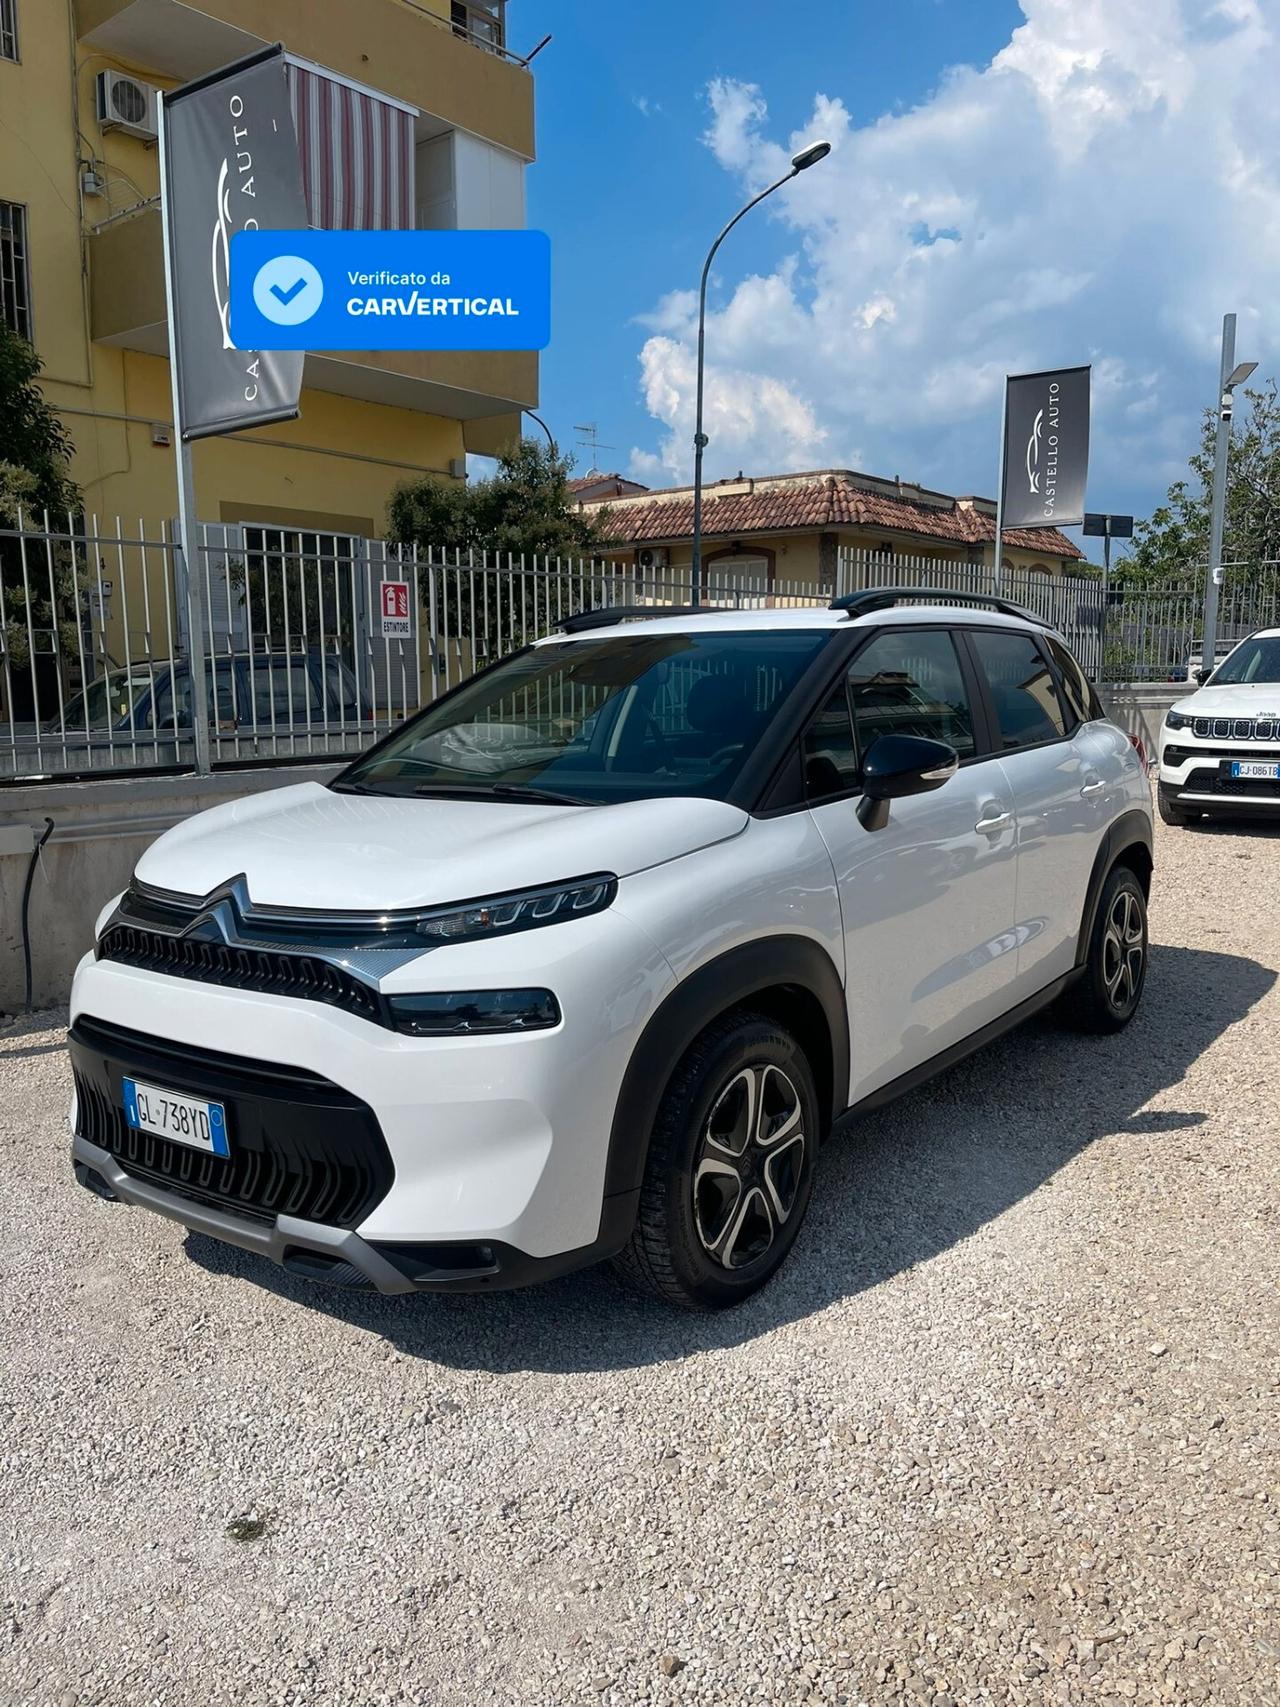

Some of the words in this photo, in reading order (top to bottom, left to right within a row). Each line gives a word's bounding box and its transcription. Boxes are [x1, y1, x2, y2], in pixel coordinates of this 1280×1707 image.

[230, 95, 255, 197] AUTO
[1049, 383, 1060, 428] AUTO
[1044, 436, 1058, 517] CASTELLO
[384, 622, 409, 632] ESTINTORE
